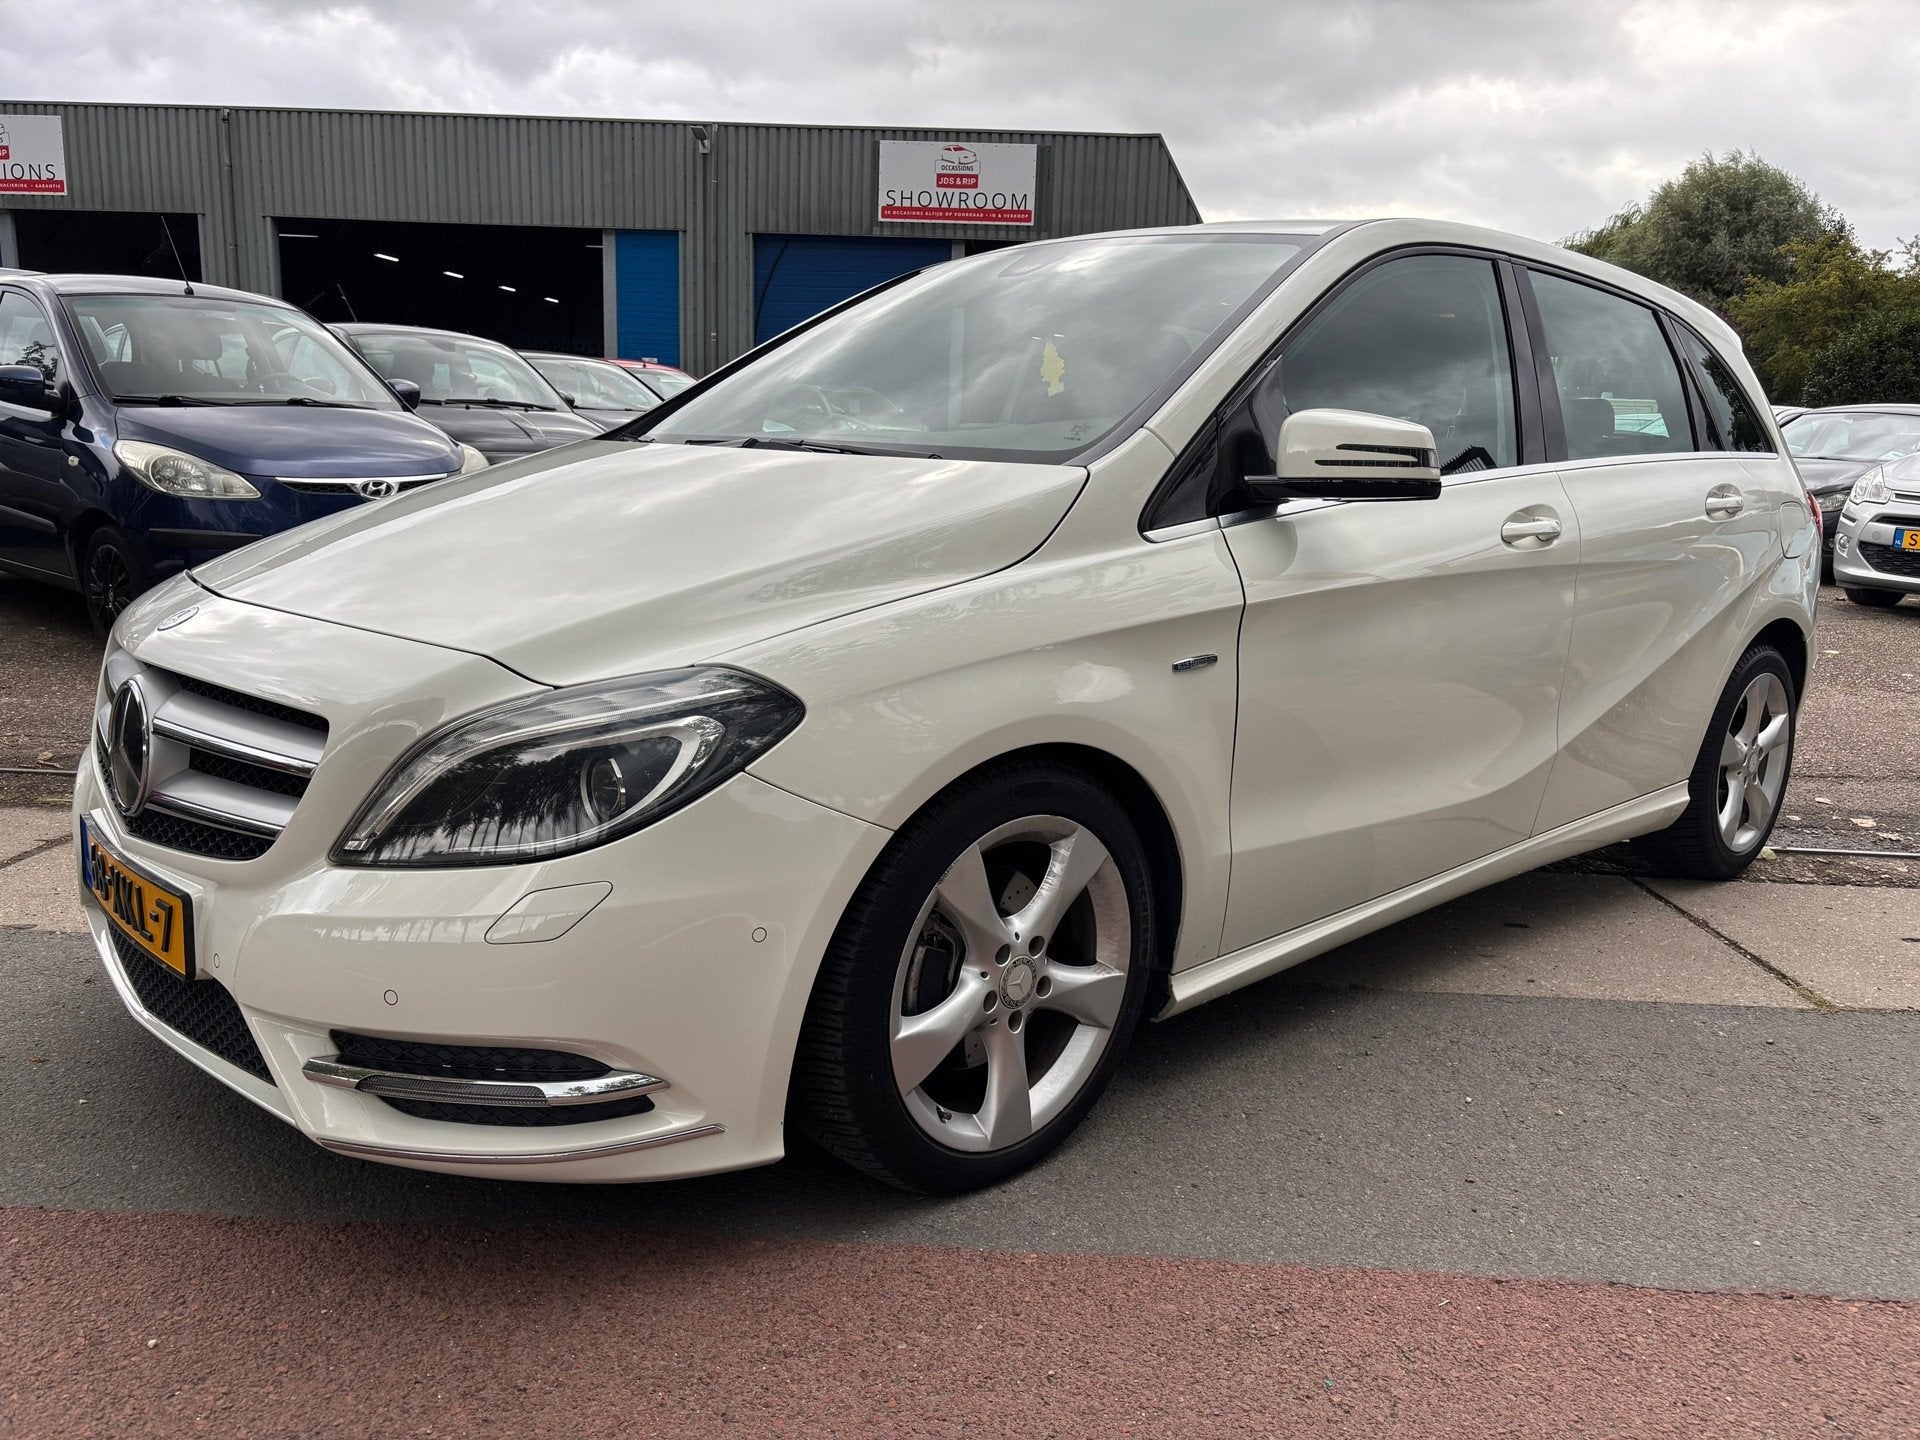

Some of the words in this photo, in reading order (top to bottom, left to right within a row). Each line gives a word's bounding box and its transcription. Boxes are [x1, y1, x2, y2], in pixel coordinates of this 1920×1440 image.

[3, 163, 56, 180] IONS
[938, 177, 954, 185] JDS
[956, 177, 961, 185] &
[886, 190, 1028, 210] SHOWROOM
